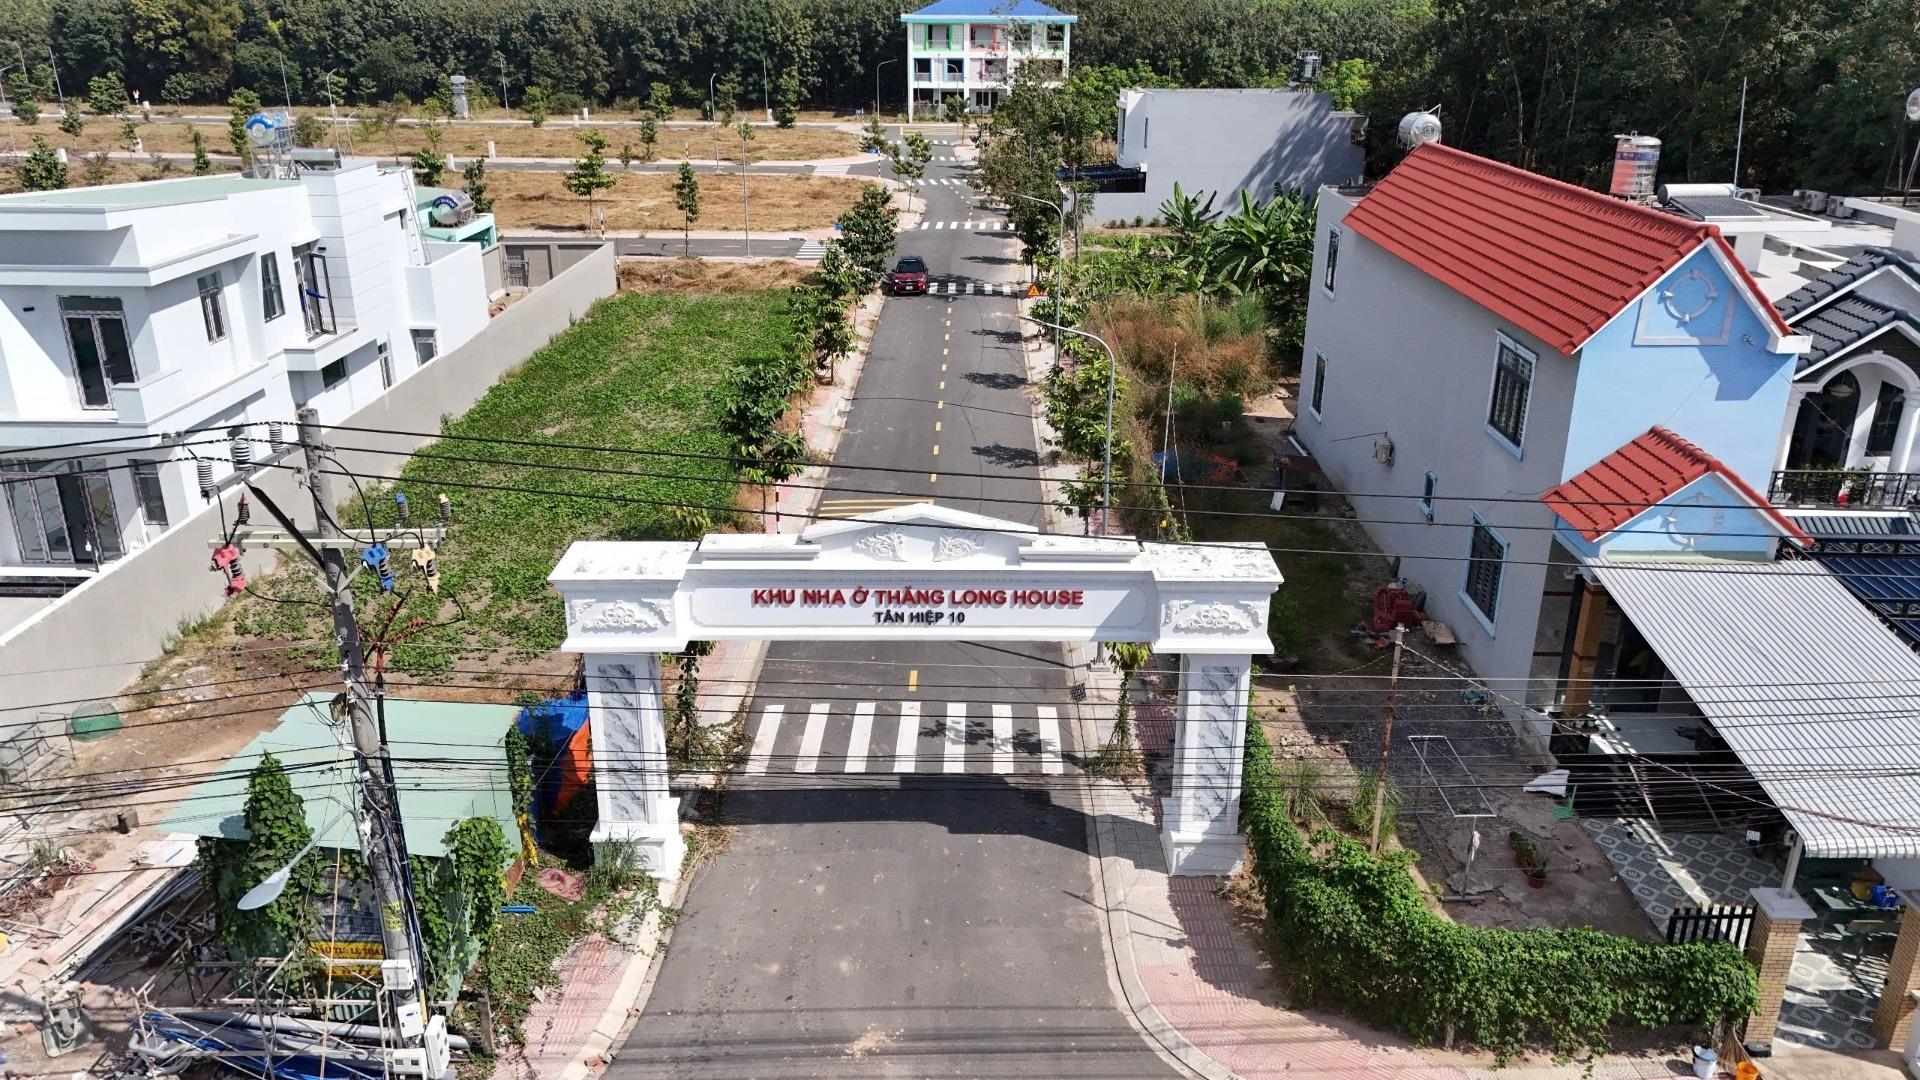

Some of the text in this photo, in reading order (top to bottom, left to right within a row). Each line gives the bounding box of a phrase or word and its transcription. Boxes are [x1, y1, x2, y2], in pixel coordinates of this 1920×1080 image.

[752, 585, 1084, 607] KHU NHA Ở THĂNG LONG HOUSE
[873, 609, 965, 625] TÂN HIỆP 10
